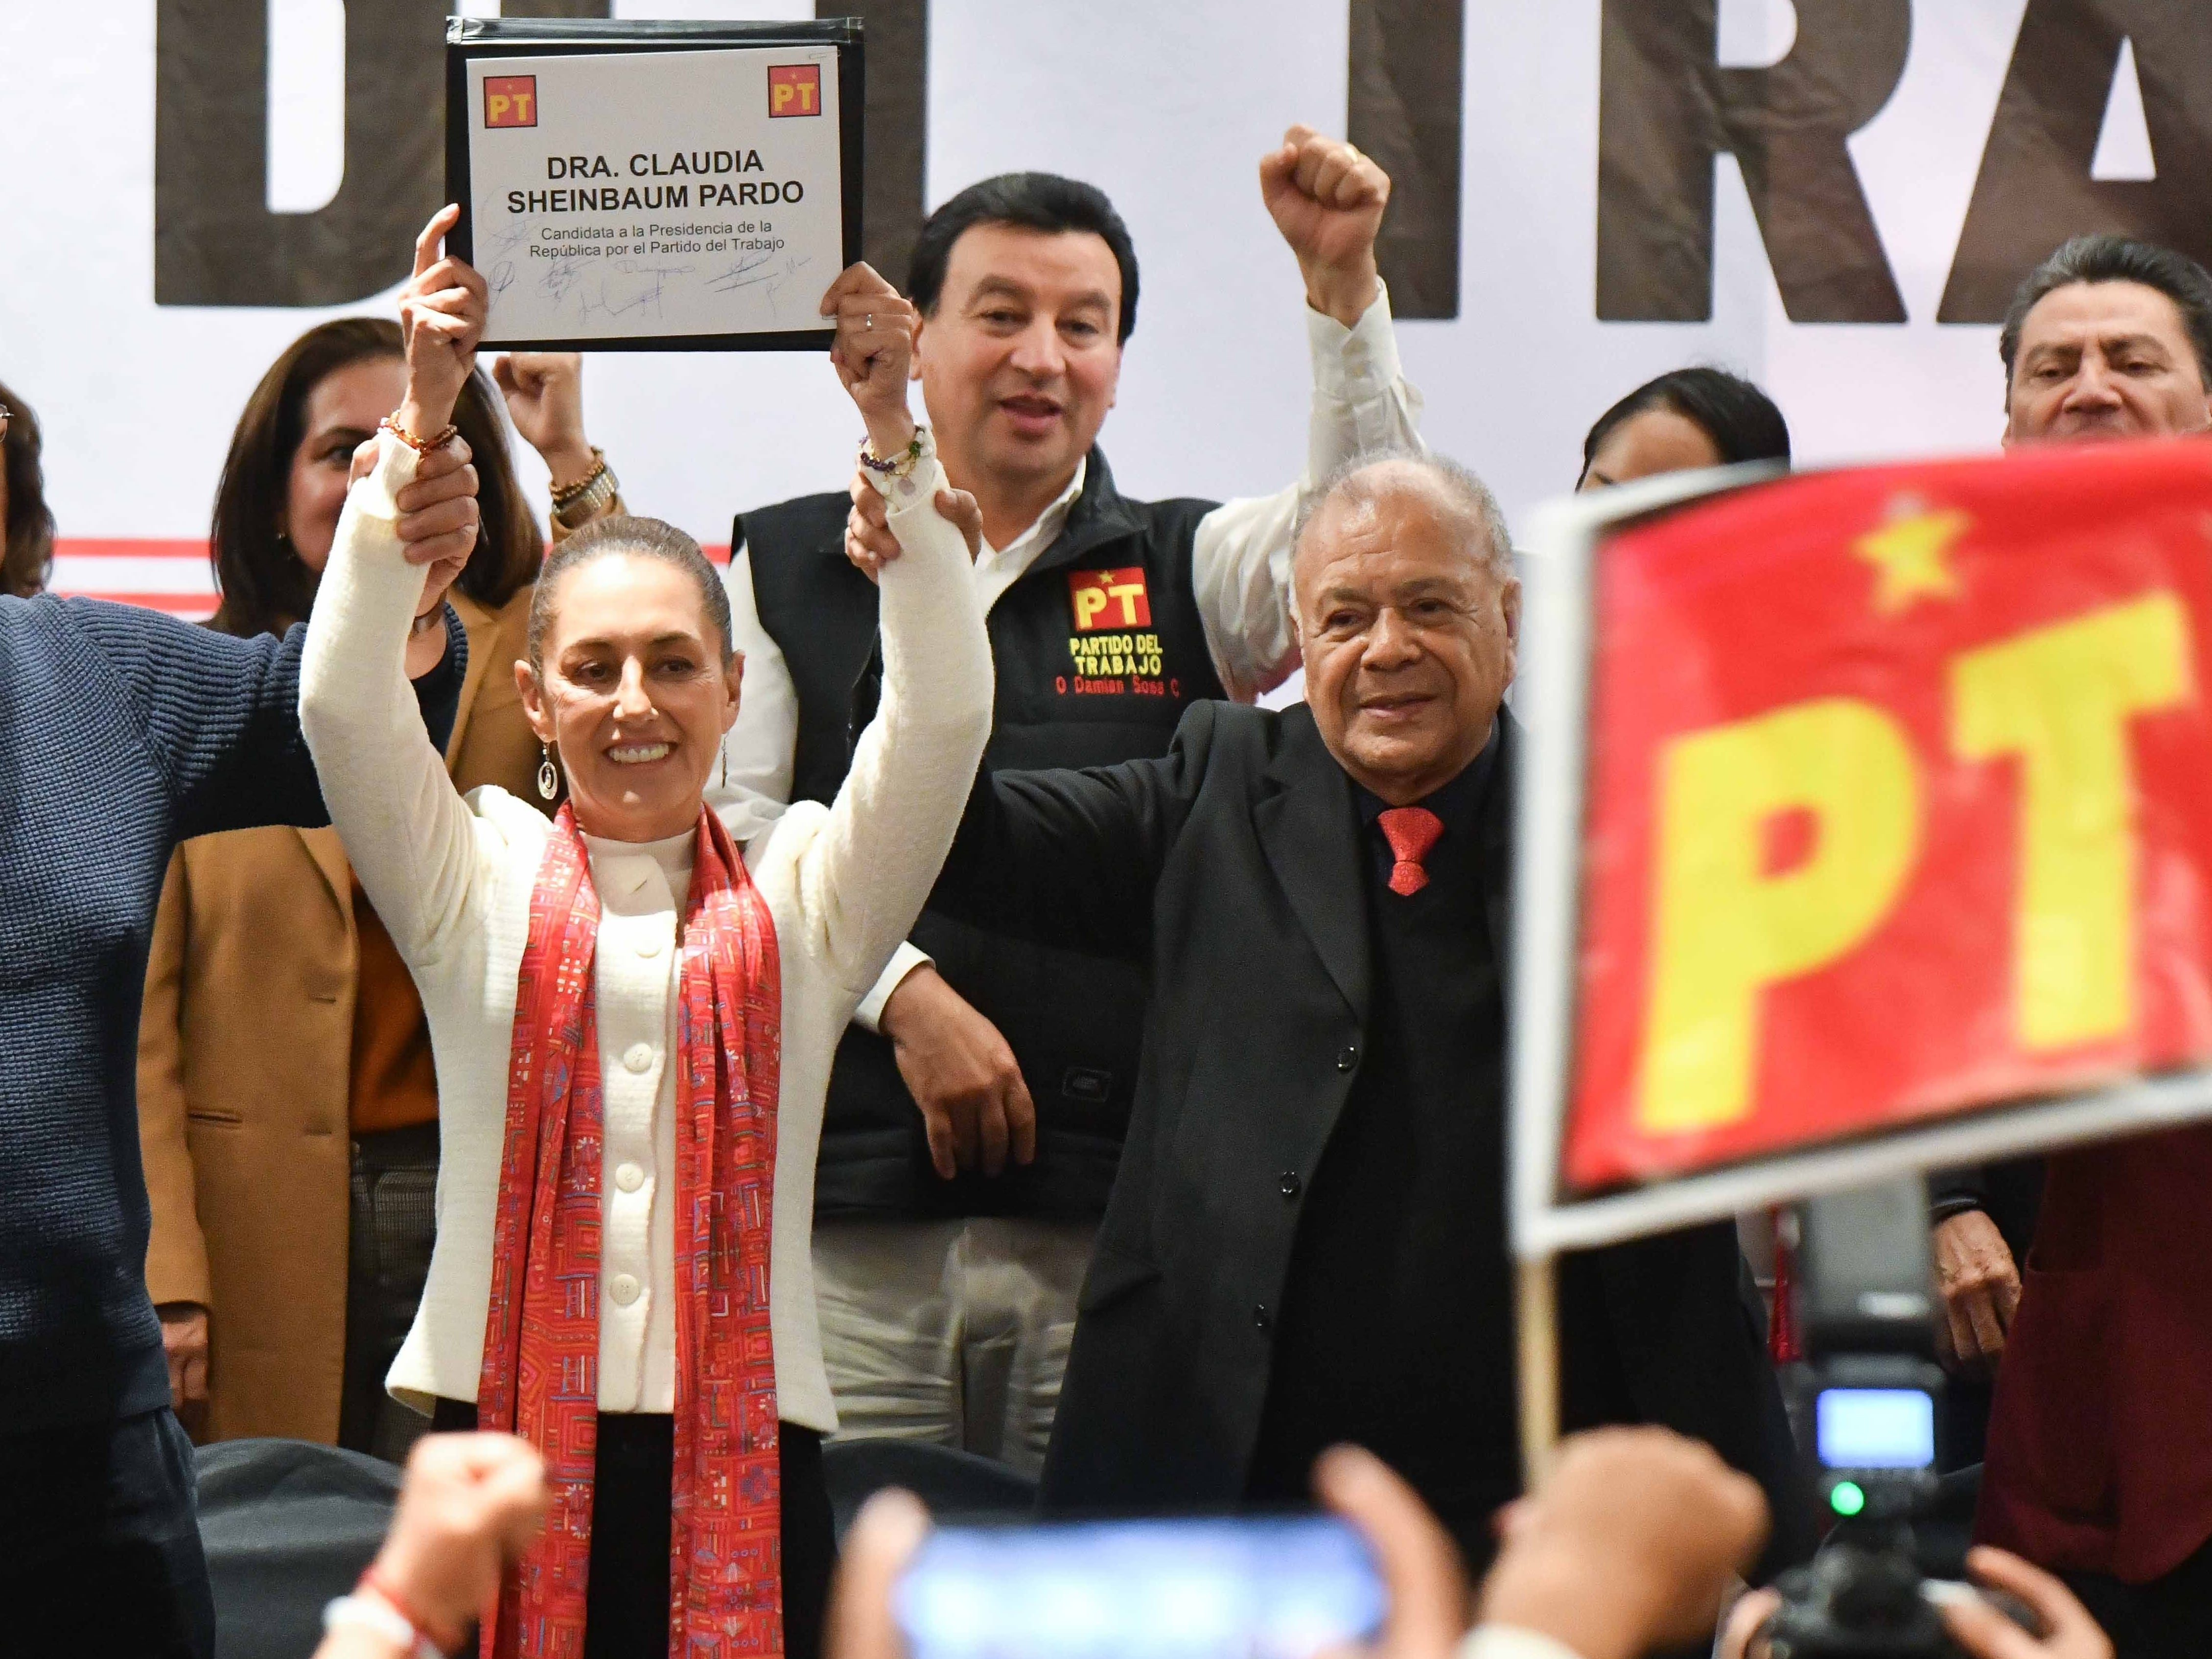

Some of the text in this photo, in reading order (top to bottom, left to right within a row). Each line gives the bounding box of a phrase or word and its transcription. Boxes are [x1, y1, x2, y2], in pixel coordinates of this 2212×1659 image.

[489, 94, 531, 122] PT
[774, 82, 815, 112] PT
[548, 150, 764, 180] DRA. CLAUDIA
[507, 181, 804, 214] SHEINBAUM PARDO
[541, 220, 772, 241] Candidata a la Presidencia de la
[530, 236, 785, 260] República por el Partido del Trabajo
[1075, 583, 1144, 630] PT
[1069, 634, 1163, 656] PARTIDO DEL
[1074, 654, 1162, 676] TRABAJO
[1632, 590, 2196, 1135] PT
